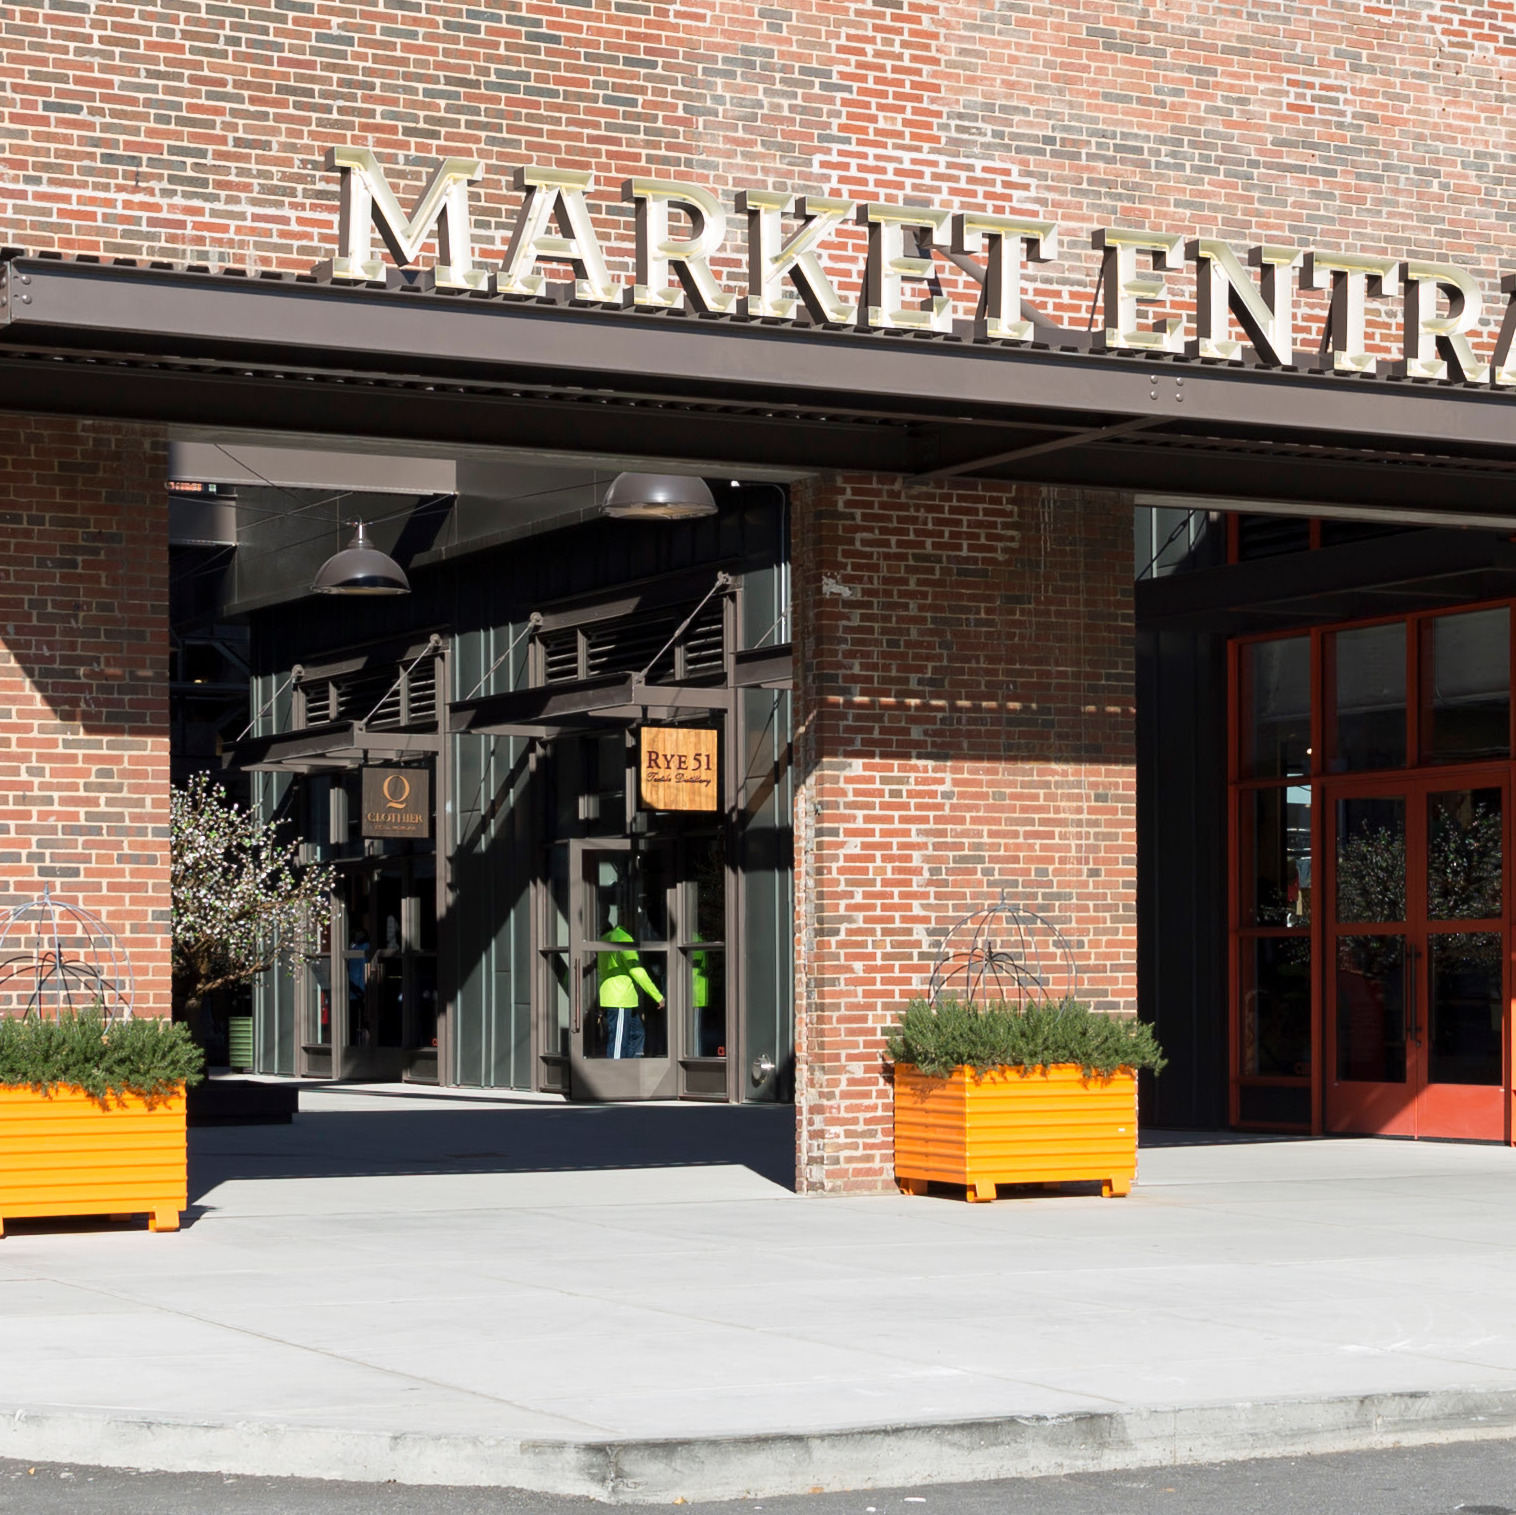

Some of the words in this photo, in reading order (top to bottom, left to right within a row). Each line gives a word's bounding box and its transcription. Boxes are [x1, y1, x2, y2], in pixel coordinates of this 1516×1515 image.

[324, 145, 1059, 344] MARKET
[646, 750, 689, 771] RYE
[691, 752, 712, 772] 51
[382, 774, 411, 810] Q
[367, 811, 423, 824] CLOTHIER
